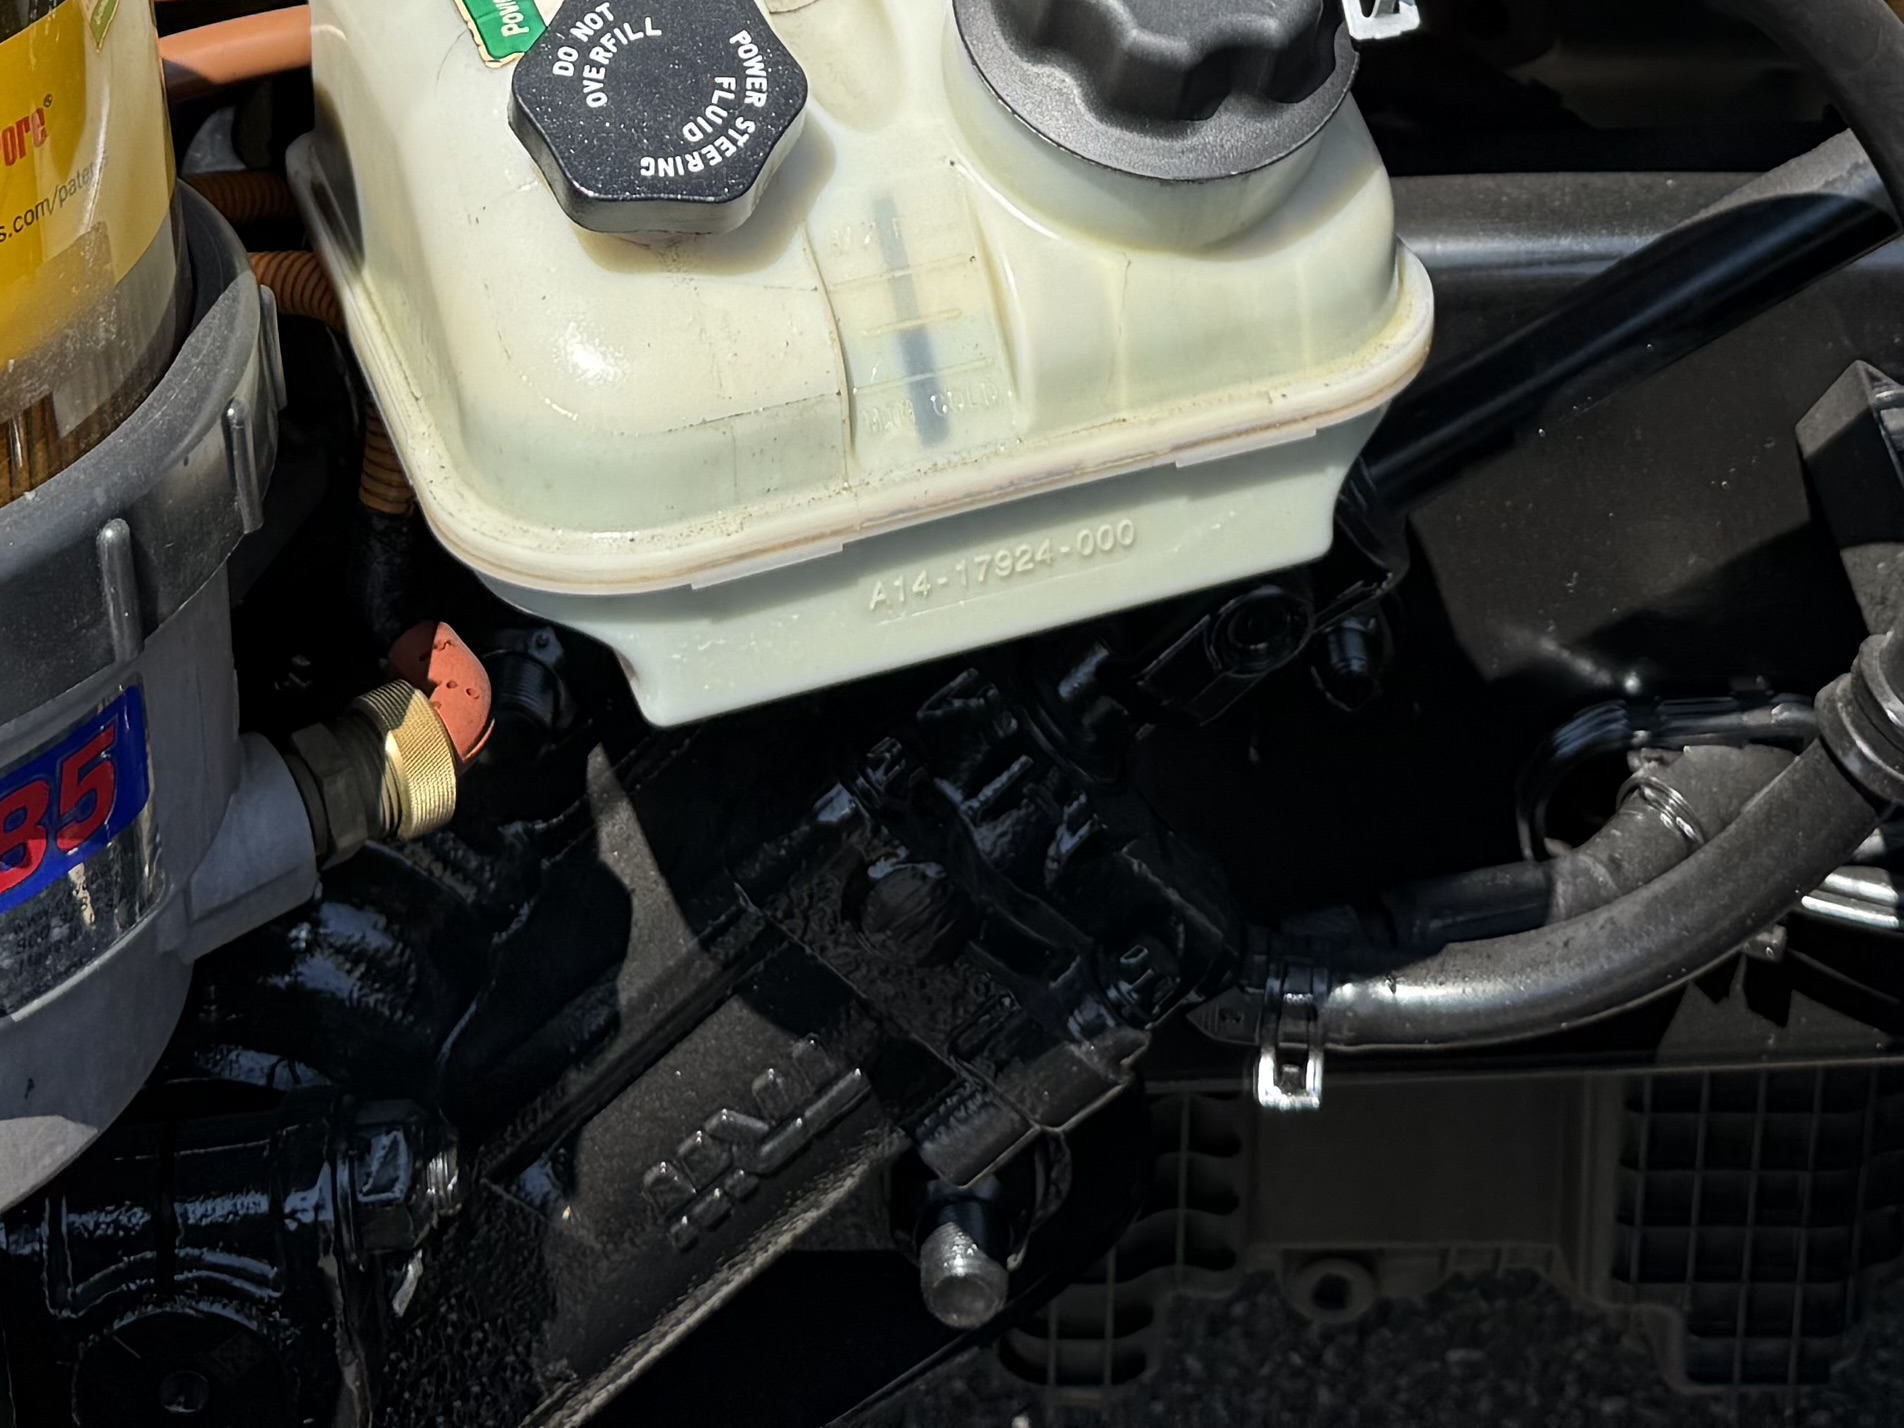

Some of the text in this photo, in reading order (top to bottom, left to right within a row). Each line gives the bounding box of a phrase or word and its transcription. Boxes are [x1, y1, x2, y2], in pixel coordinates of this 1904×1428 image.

[552, 1, 615, 78] DO NOT
[582, 16, 662, 109] OVERFILL
[640, 29, 769, 178] POWER STEERING
[681, 75, 737, 143] FLUID
[867, 515, 1136, 613] A14-17924-000
